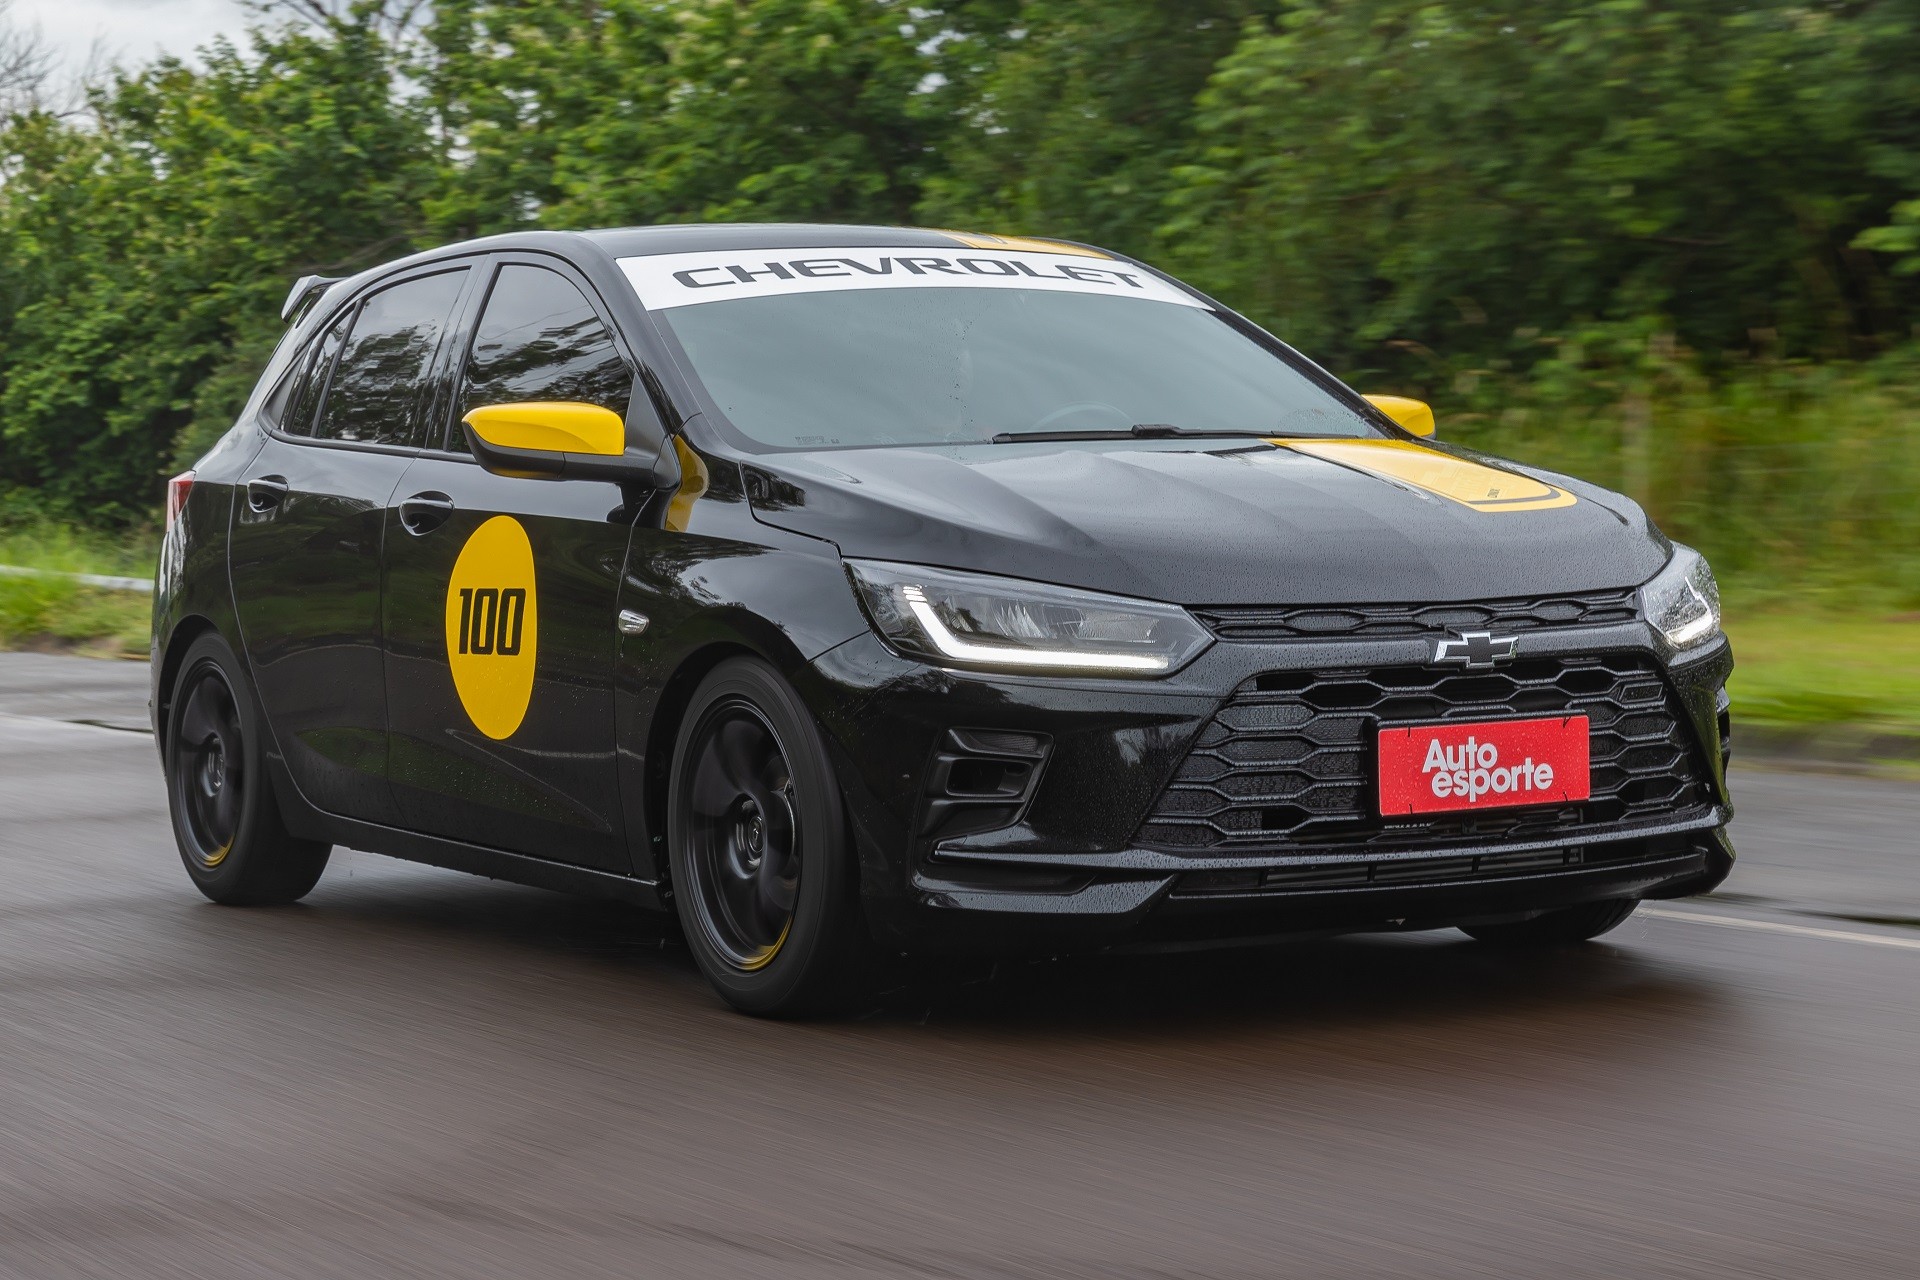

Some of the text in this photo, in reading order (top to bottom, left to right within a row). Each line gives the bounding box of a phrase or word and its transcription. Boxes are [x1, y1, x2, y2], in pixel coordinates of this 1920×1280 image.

[672, 256, 1144, 289] CHEVROLET
[458, 587, 527, 656] 100
[1422, 736, 1498, 773] Auto
[1431, 757, 1554, 803] esporte
